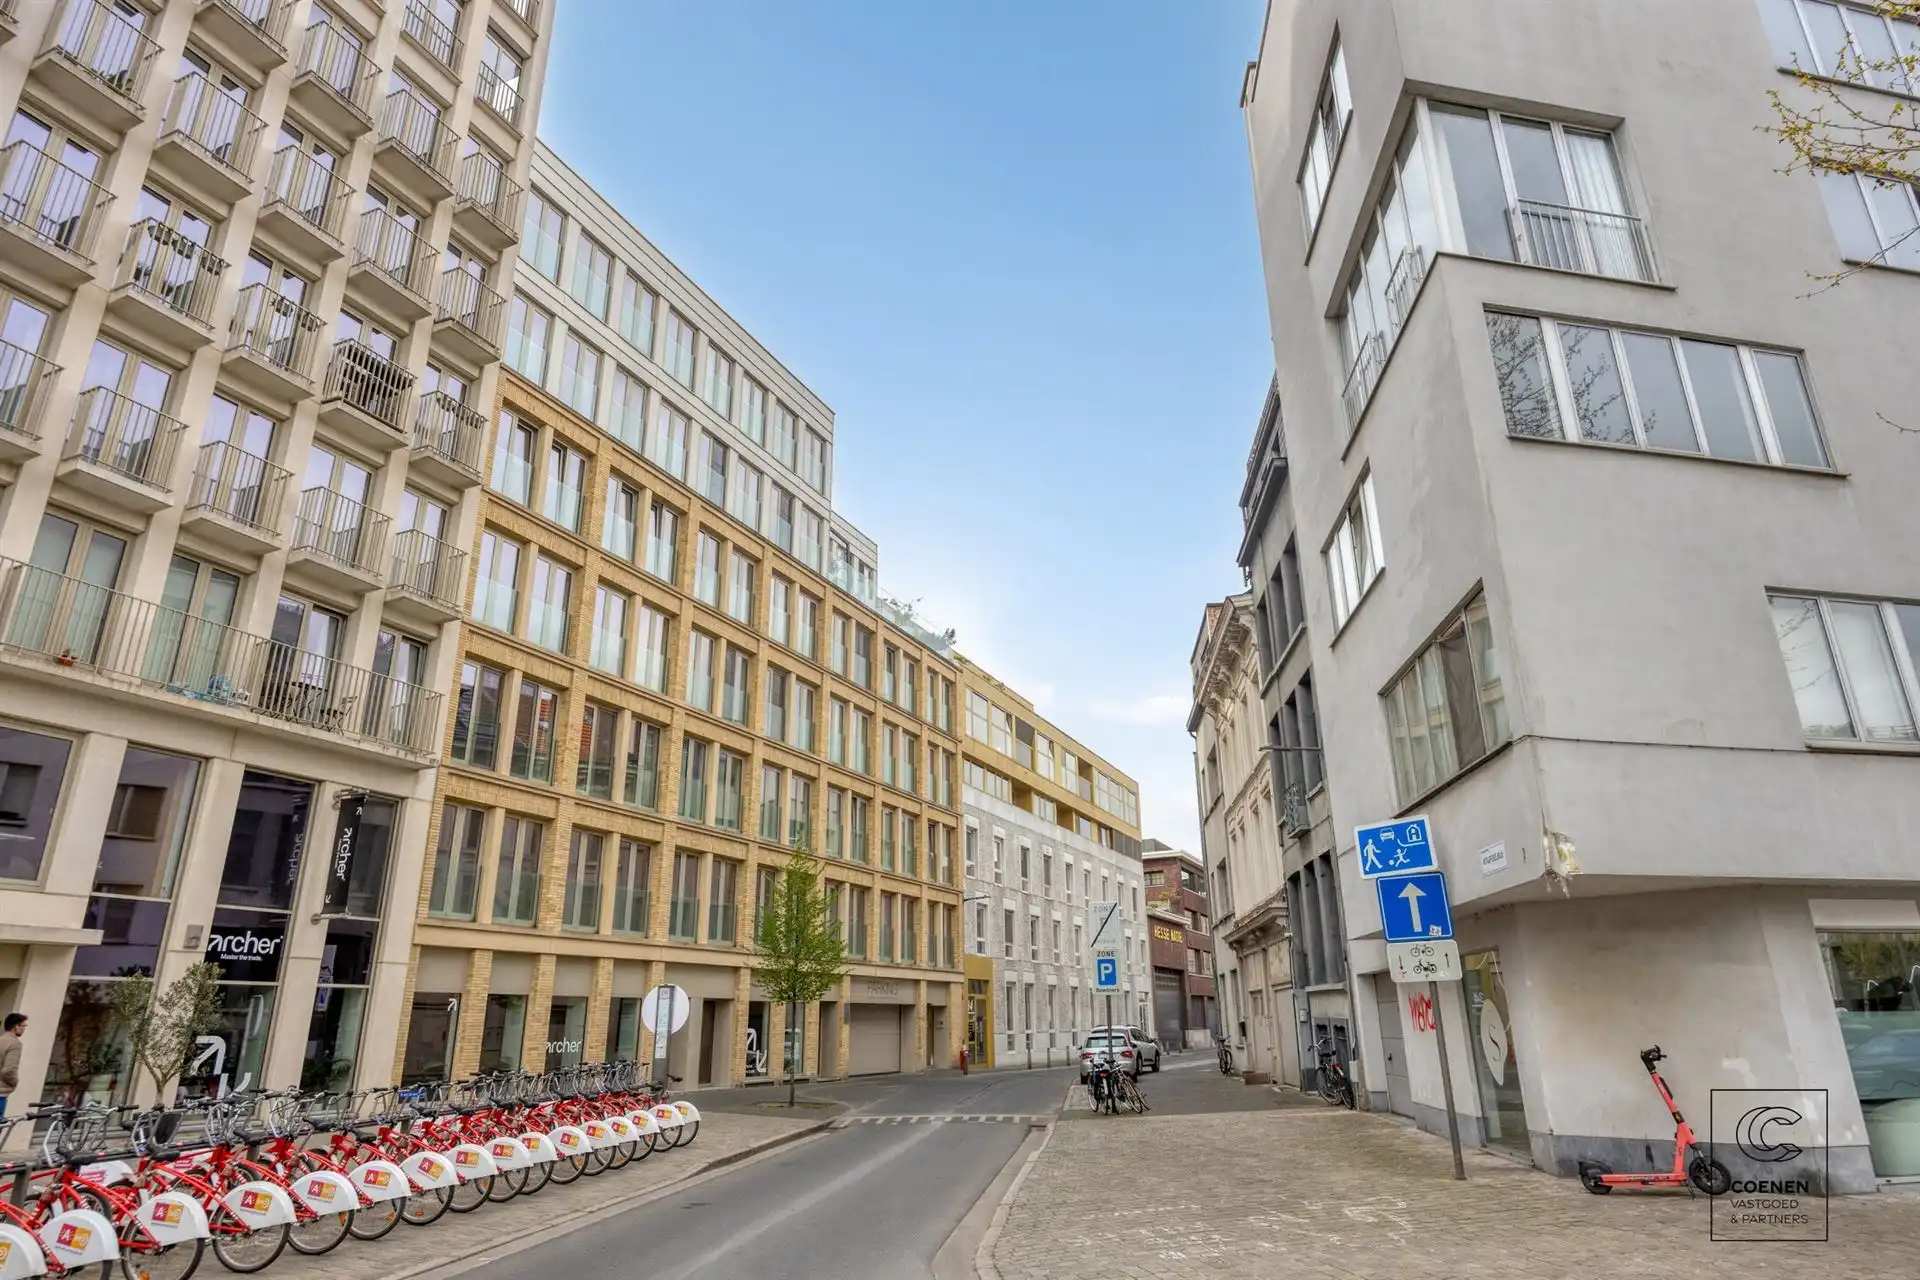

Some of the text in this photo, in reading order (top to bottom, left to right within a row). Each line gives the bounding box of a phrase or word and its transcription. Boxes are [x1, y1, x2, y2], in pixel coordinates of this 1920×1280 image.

[336, 827, 353, 882] archer
[207, 930, 281, 955] archer
[1097, 950, 1116, 958] ZONE
[1100, 963, 1113, 982] P
